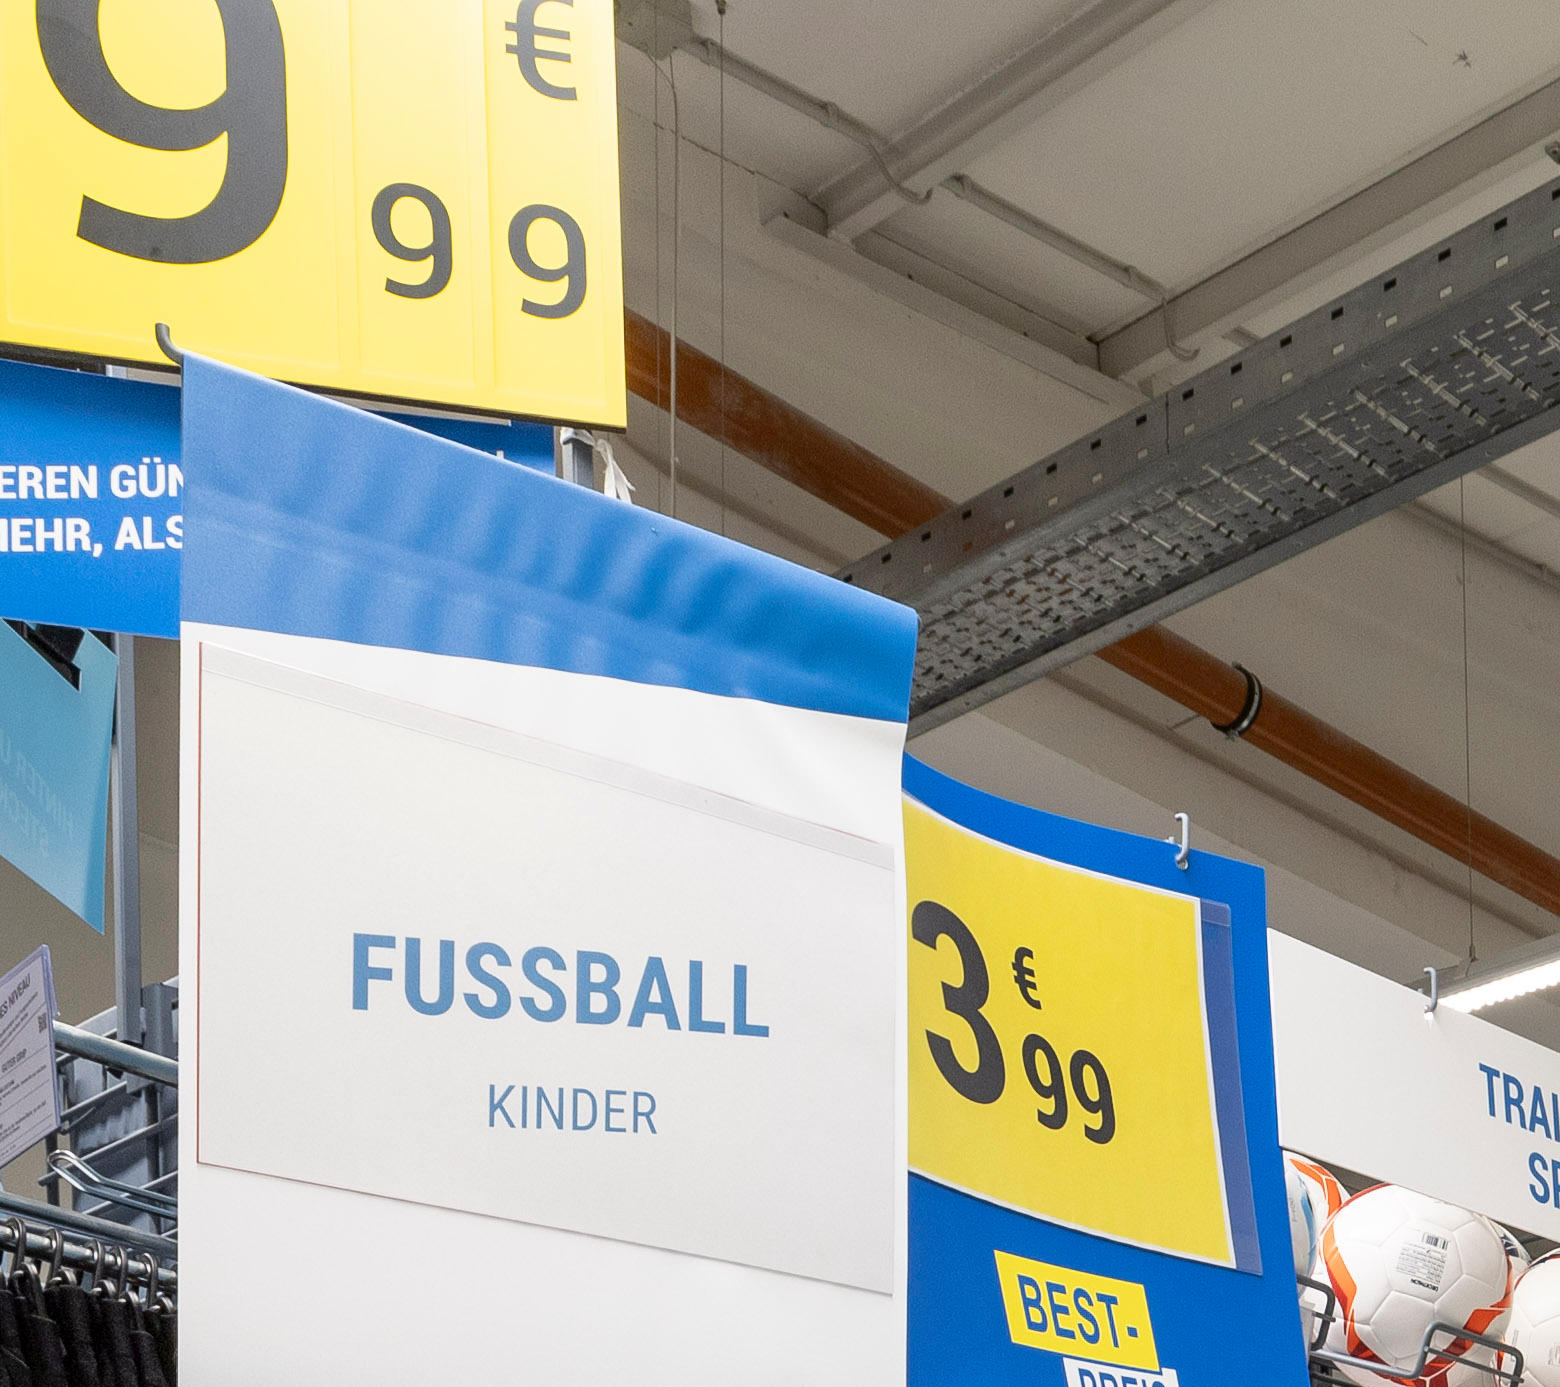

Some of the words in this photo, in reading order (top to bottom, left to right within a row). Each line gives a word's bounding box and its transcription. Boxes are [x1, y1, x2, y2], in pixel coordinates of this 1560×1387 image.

[35, 0, 288, 264] 9
[115, 514, 183, 549] ALS
[352, 933, 770, 1038] FUSSBALL
[911, 900, 1006, 1104] 3
[488, 1084, 657, 1135] KINDER
[1021, 1032, 1116, 1145] 99
[1016, 1273, 1139, 1349] BEST-
